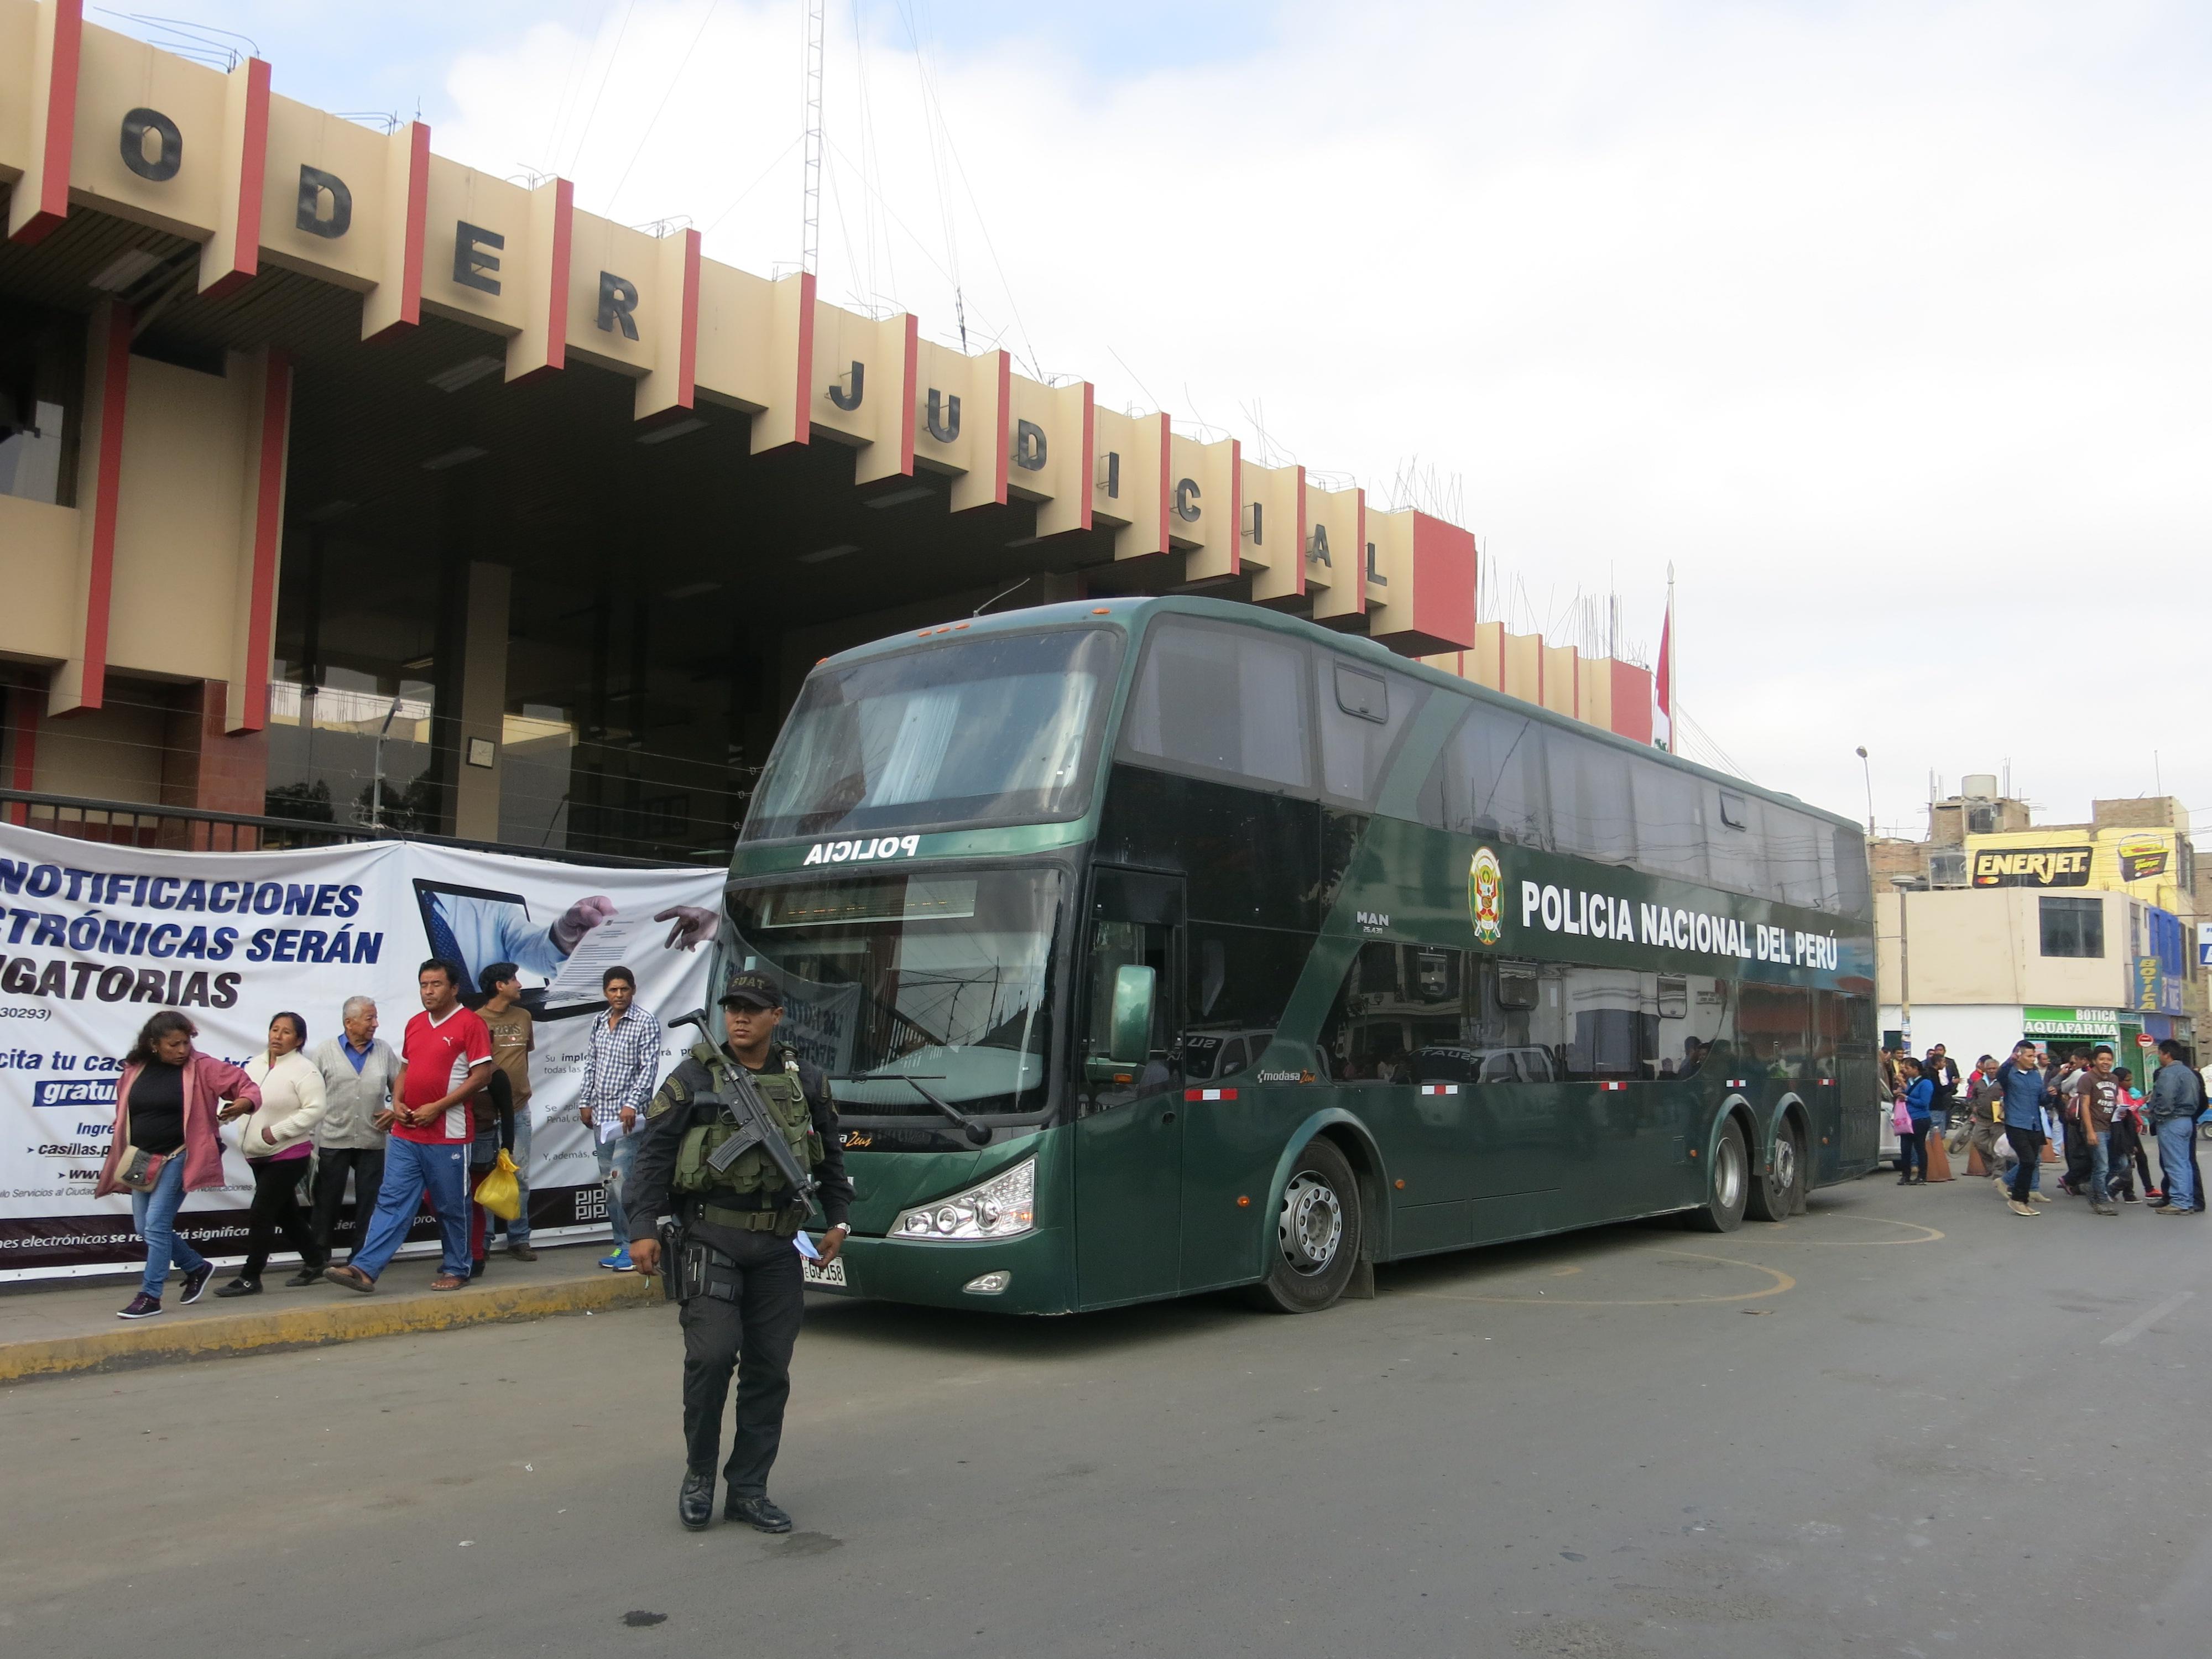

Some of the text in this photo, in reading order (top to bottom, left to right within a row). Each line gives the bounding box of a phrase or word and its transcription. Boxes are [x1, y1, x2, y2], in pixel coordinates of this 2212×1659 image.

[120, 108, 1387, 586] ODER JUDICIAL
[1977, 852, 2089, 884] ENERJET
[0, 859, 362, 917] NOTIFICACIONES
[1357, 911, 1389, 926] MAN
[1521, 880, 1838, 971] POLICIA NACIONAL DEL PERÚ
[246, 924, 383, 963] SERÁN
[732, 976, 765, 989] SUAT
[2139, 959, 2156, 1010] BOTICA
[2077, 1009, 2116, 1022] BOTICA
[2025, 1021, 2117, 1035] AQUAFARMA
[51, 1051, 77, 1070] tu
[1264, 1070, 1300, 1081] modasa
[547, 1114, 570, 1124] Penal,
[553, 1150, 590, 1160] además,
[12, 1188, 53, 1198] Servicios
[55, 1187, 63, 1196] al
[22, 1234, 107, 1248] electrónicas
[109, 1234, 126, 1244] se
